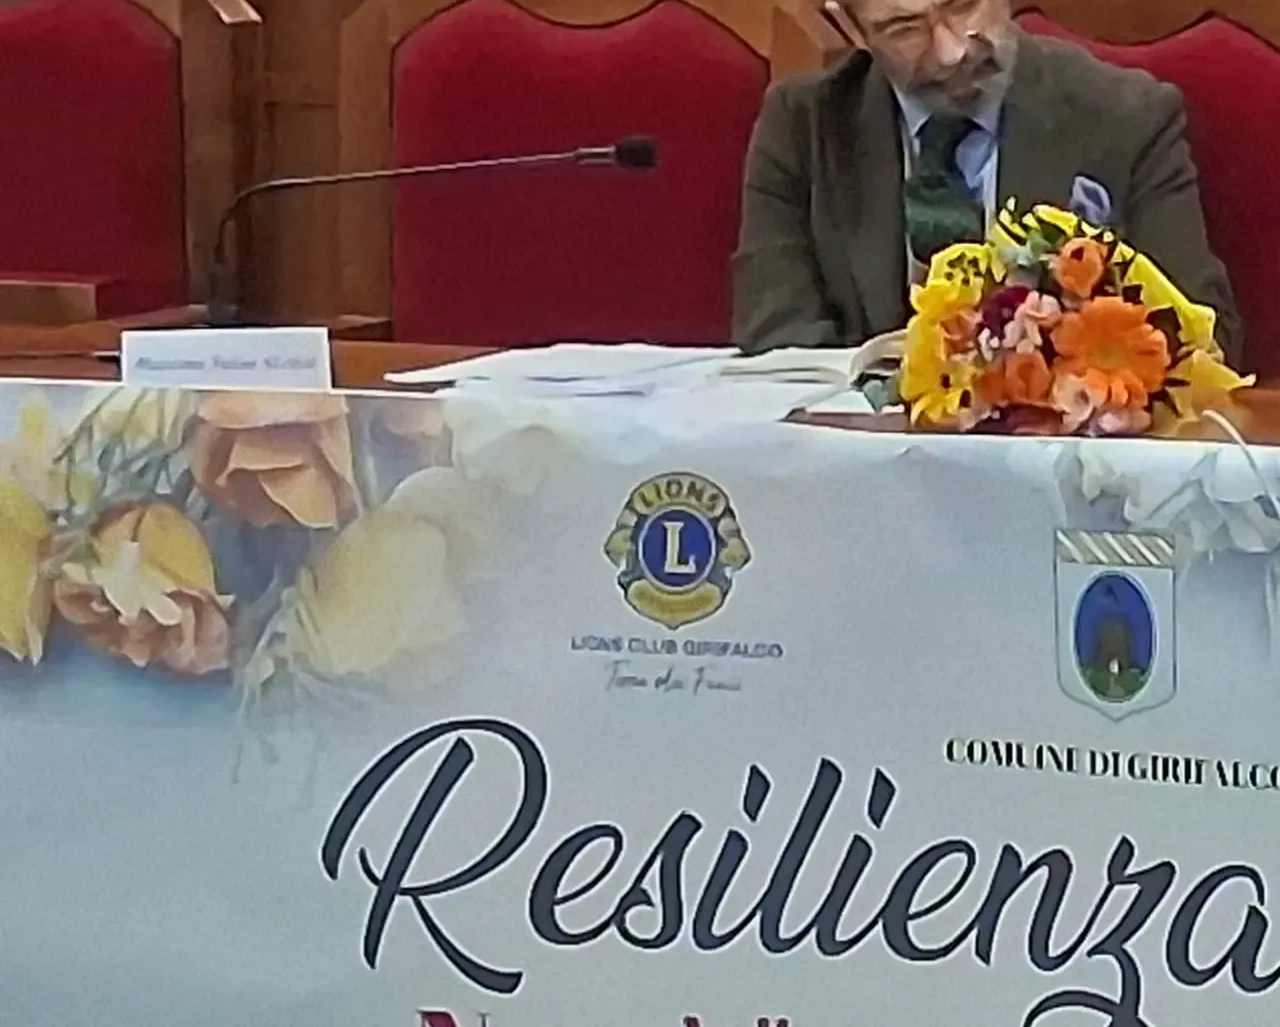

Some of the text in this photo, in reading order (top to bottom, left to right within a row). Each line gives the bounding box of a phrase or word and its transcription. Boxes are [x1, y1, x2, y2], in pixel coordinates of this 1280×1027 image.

[638, 478, 723, 511] LIONS
[662, 520, 697, 574] L
[570, 634, 624, 652] LIONS
[627, 636, 678, 655] CLUB
[945, 737, 1079, 773] COMUNE
[1089, 749, 1121, 778] DI
